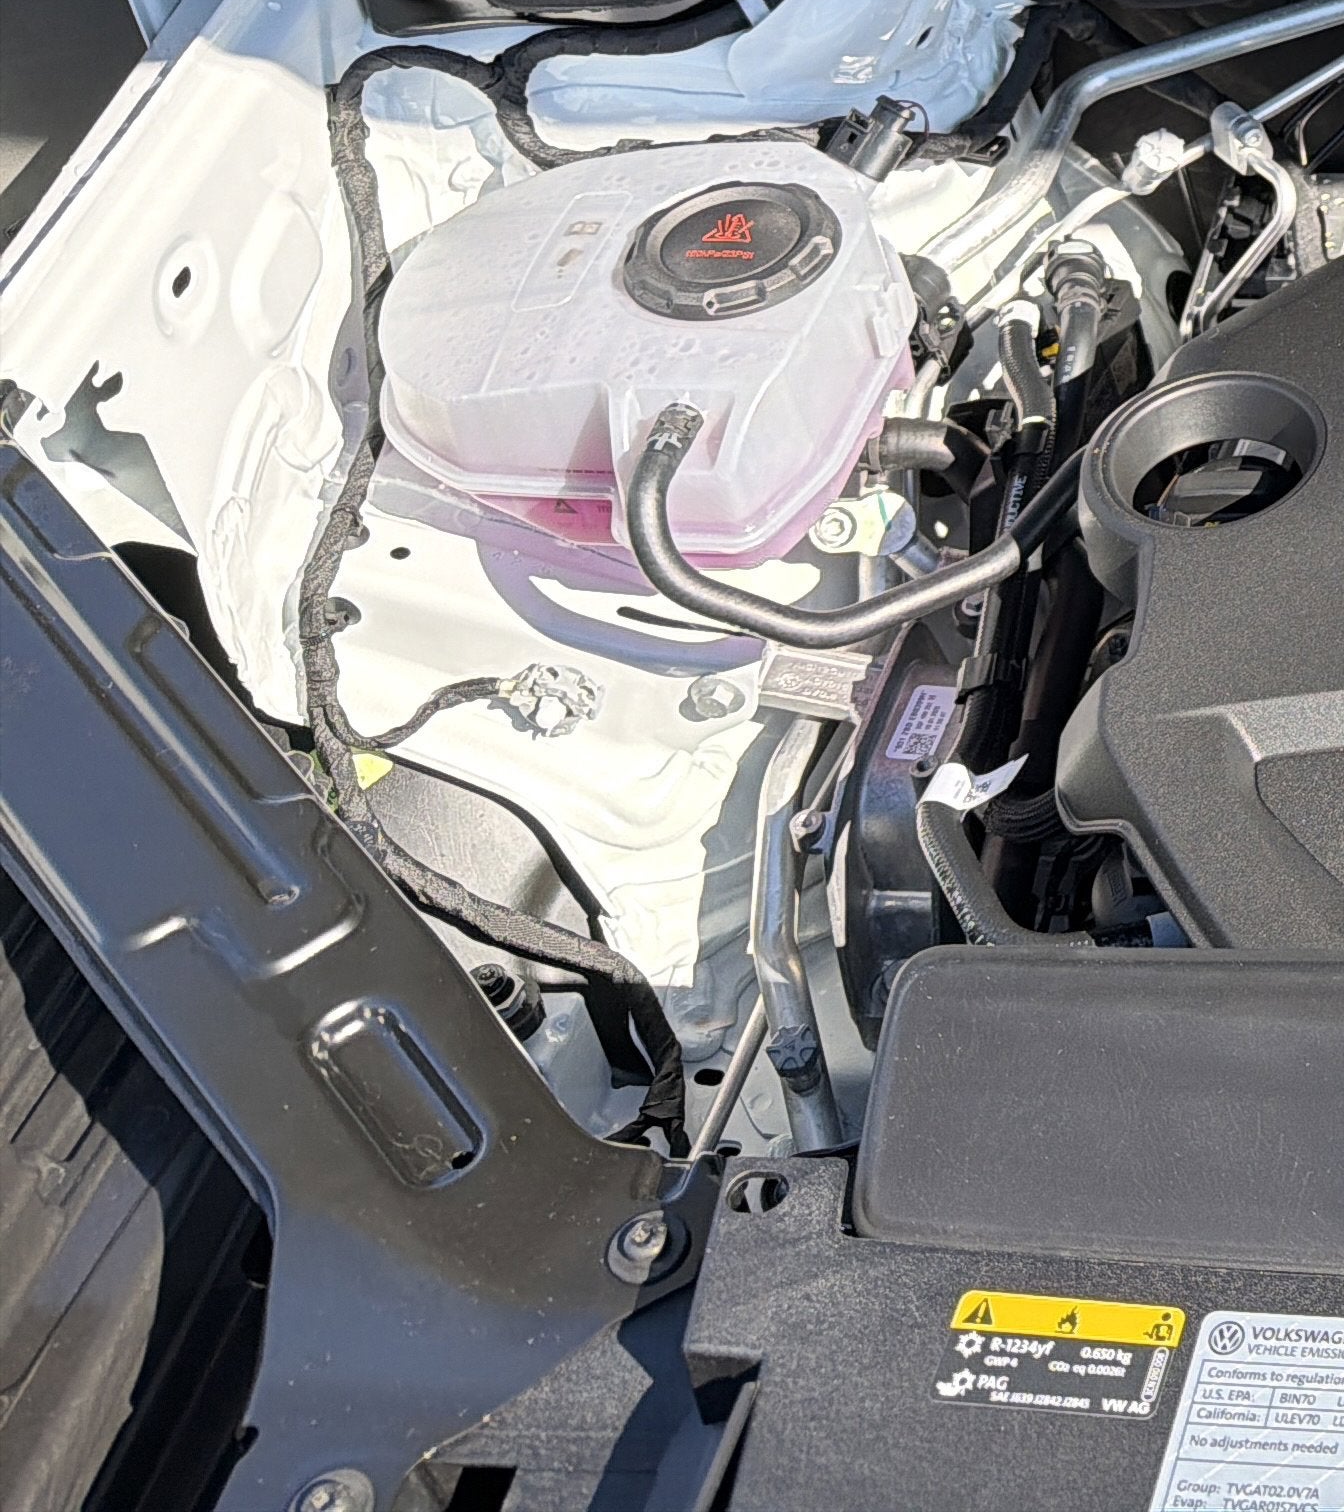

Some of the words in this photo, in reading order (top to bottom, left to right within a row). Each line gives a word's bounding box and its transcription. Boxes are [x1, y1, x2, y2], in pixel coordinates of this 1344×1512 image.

[990, 1337, 1055, 1359] R-1234yf
[1117, 1349, 1132, 1365] kg
[1248, 1343, 1297, 1358] VEHICLE
[1073, 1364, 1086, 1376] eq
[1207, 1366, 1268, 1382] Conforms
[1270, 1369, 1283, 1382] to
[977, 1375, 1009, 1390] PAG
[1102, 1397, 1128, 1412] VW
[1127, 1401, 1150, 1415] AG
[1202, 1389, 1226, 1401] U.S.
[1228, 1390, 1256, 1403] EPA:
[1279, 1392, 1317, 1406] BIN70
[1196, 1406, 1261, 1423] California:
[1274, 1412, 1321, 1426] ULEV70
[1188, 1434, 1208, 1447] No
[1209, 1437, 1289, 1452] adjustments
[1291, 1441, 1339, 1456] needed
[1177, 1479, 1221, 1497] Group:
[1173, 1495, 1208, 1511] Evap:
